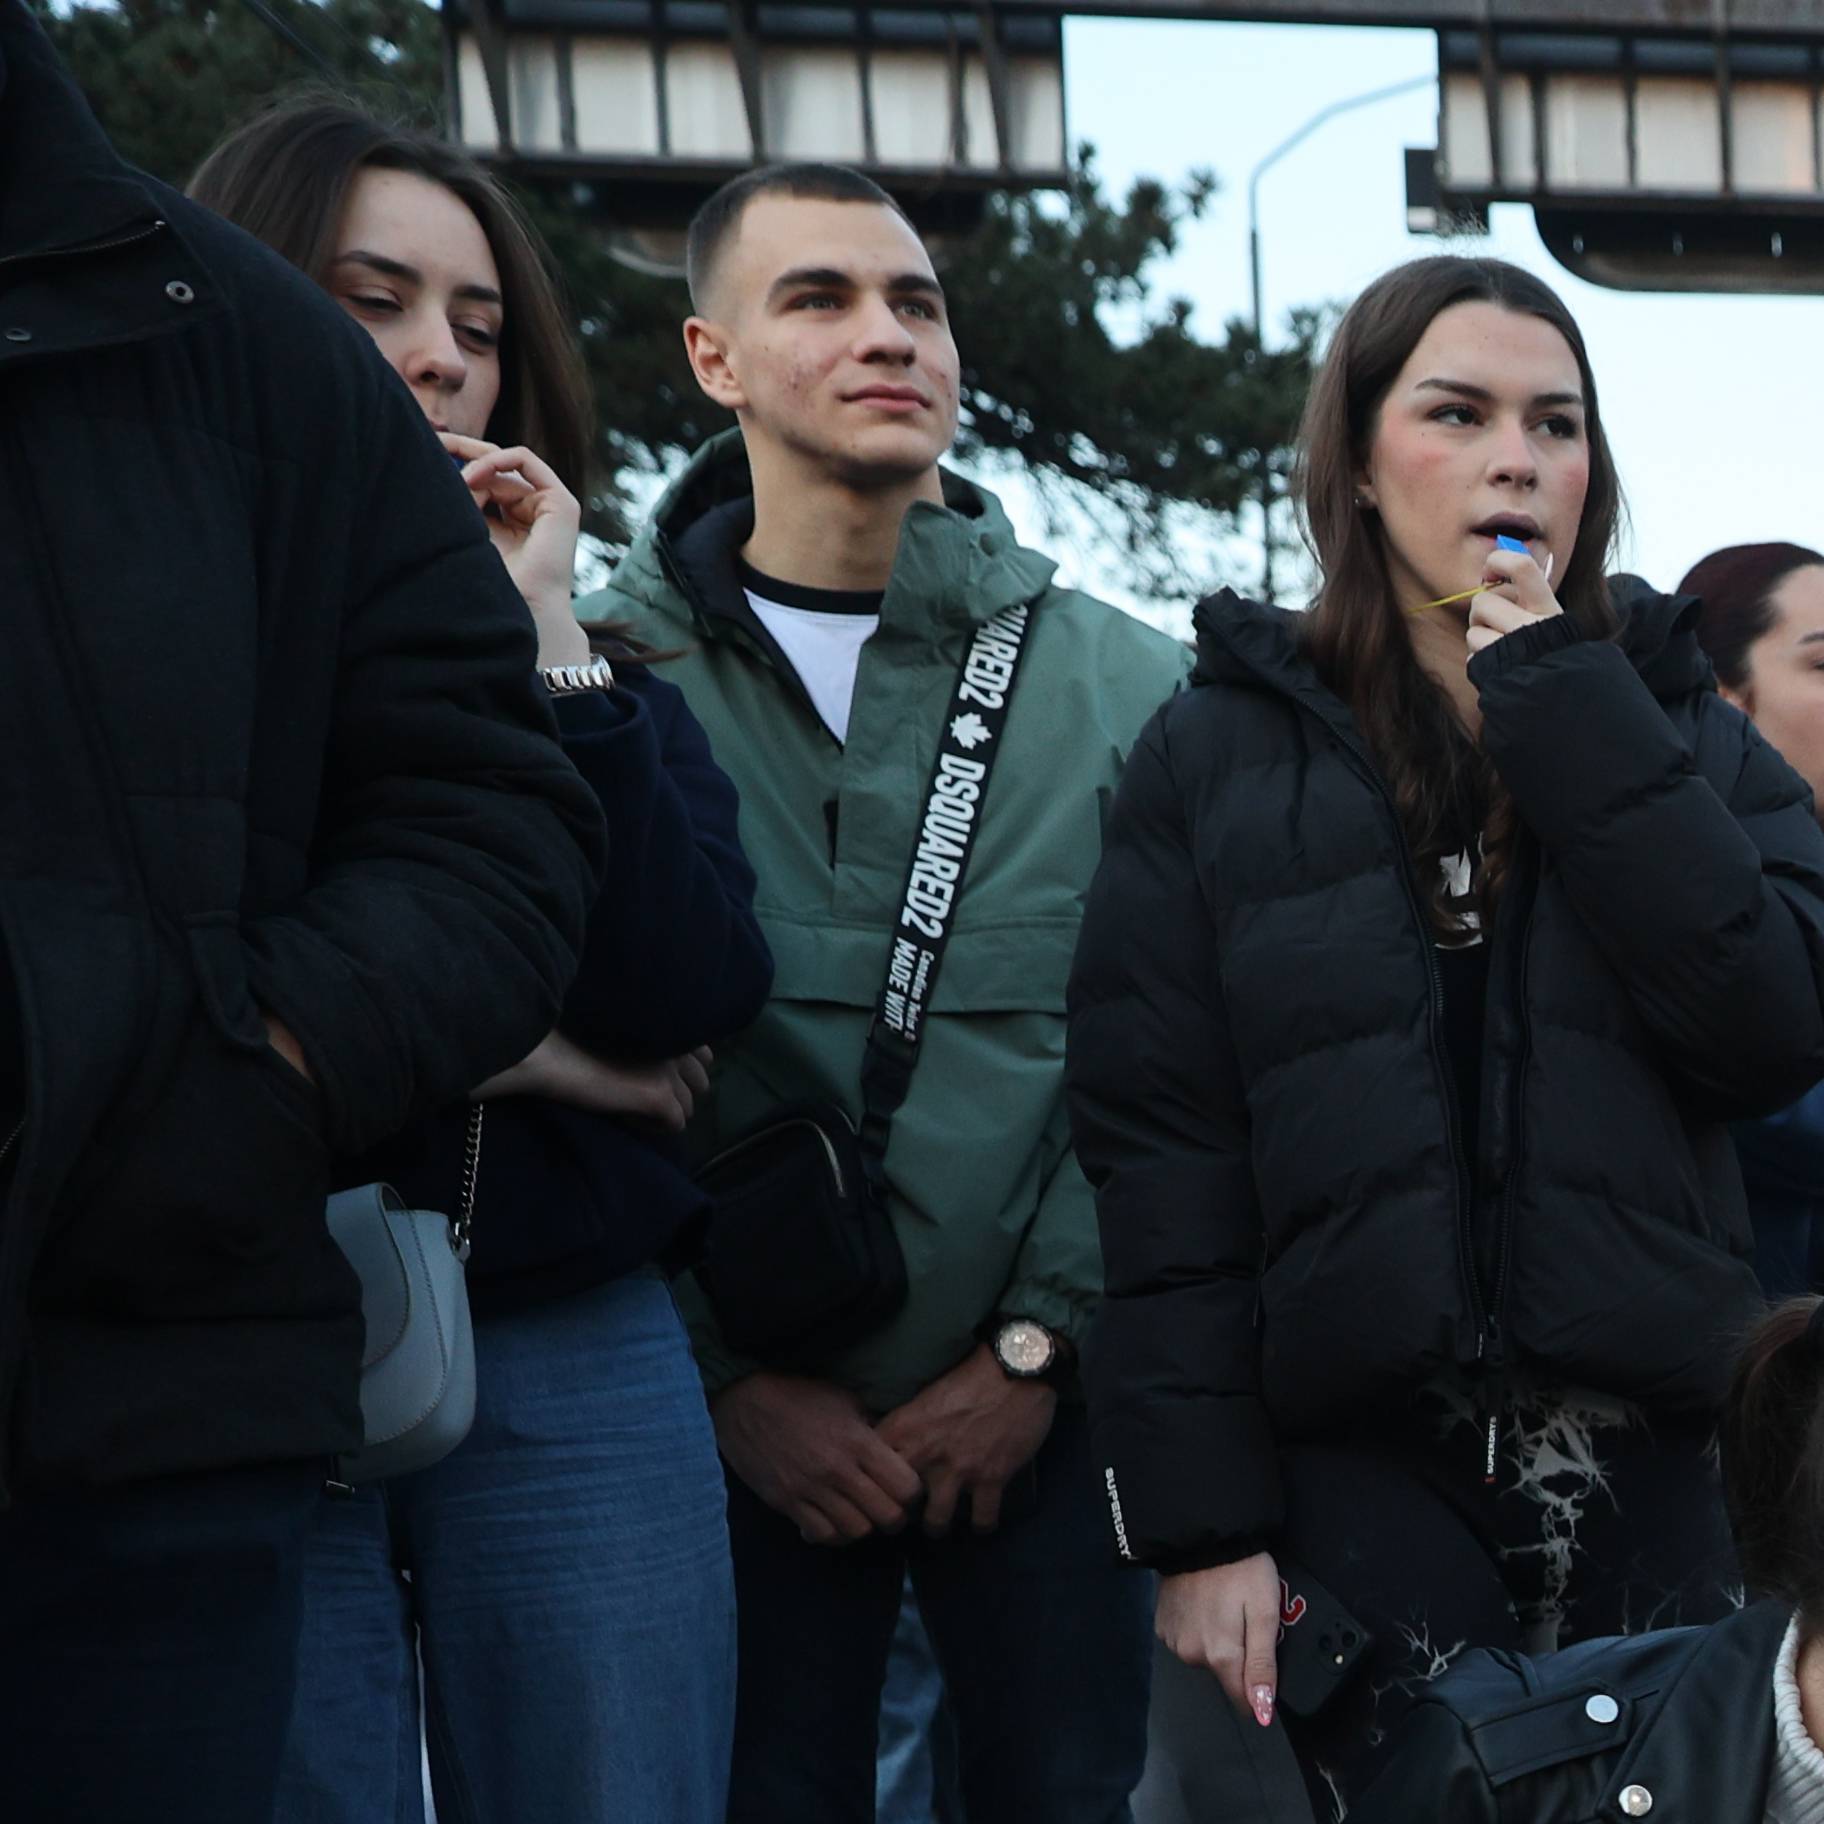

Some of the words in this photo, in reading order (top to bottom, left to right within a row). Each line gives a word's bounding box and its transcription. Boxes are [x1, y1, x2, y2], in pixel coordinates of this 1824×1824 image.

[900, 752, 986, 939] DSQUARED2
[889, 936, 918, 994] MADE
[1105, 1467, 1132, 1560] SUPERDRY
